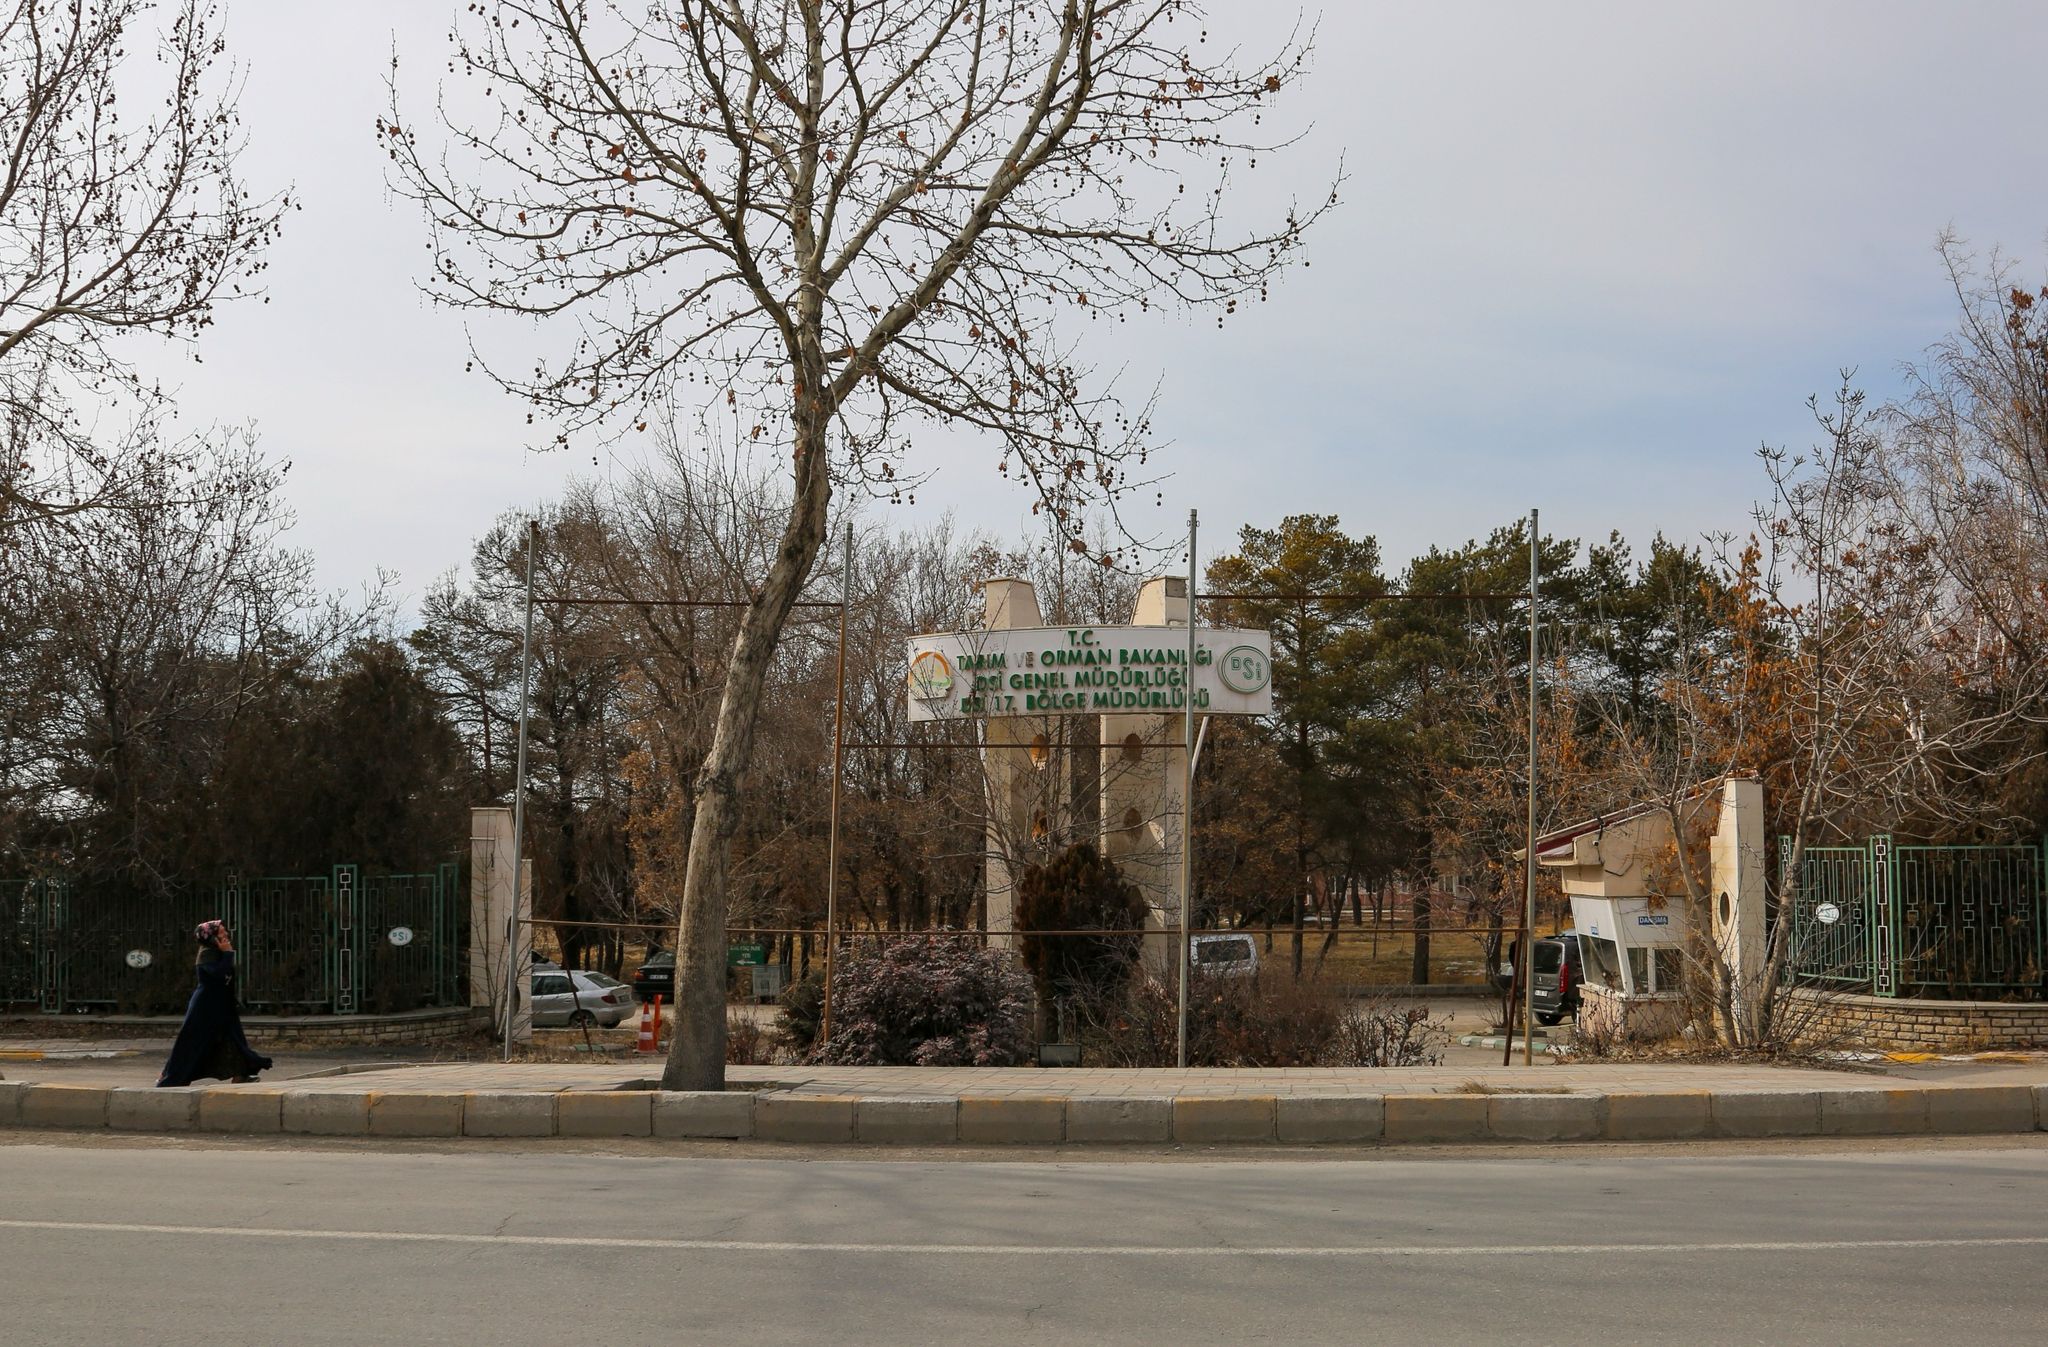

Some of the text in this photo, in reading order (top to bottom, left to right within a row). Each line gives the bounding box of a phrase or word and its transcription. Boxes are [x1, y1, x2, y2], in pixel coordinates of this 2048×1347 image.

[1068, 630, 1100, 646] T.C.
[956, 644, 1212, 671] TARIM VE ORMAN BAKANLĞI
[1009, 673, 1069, 689] GENEL
[1026, 689, 1085, 710] BÖLGE
